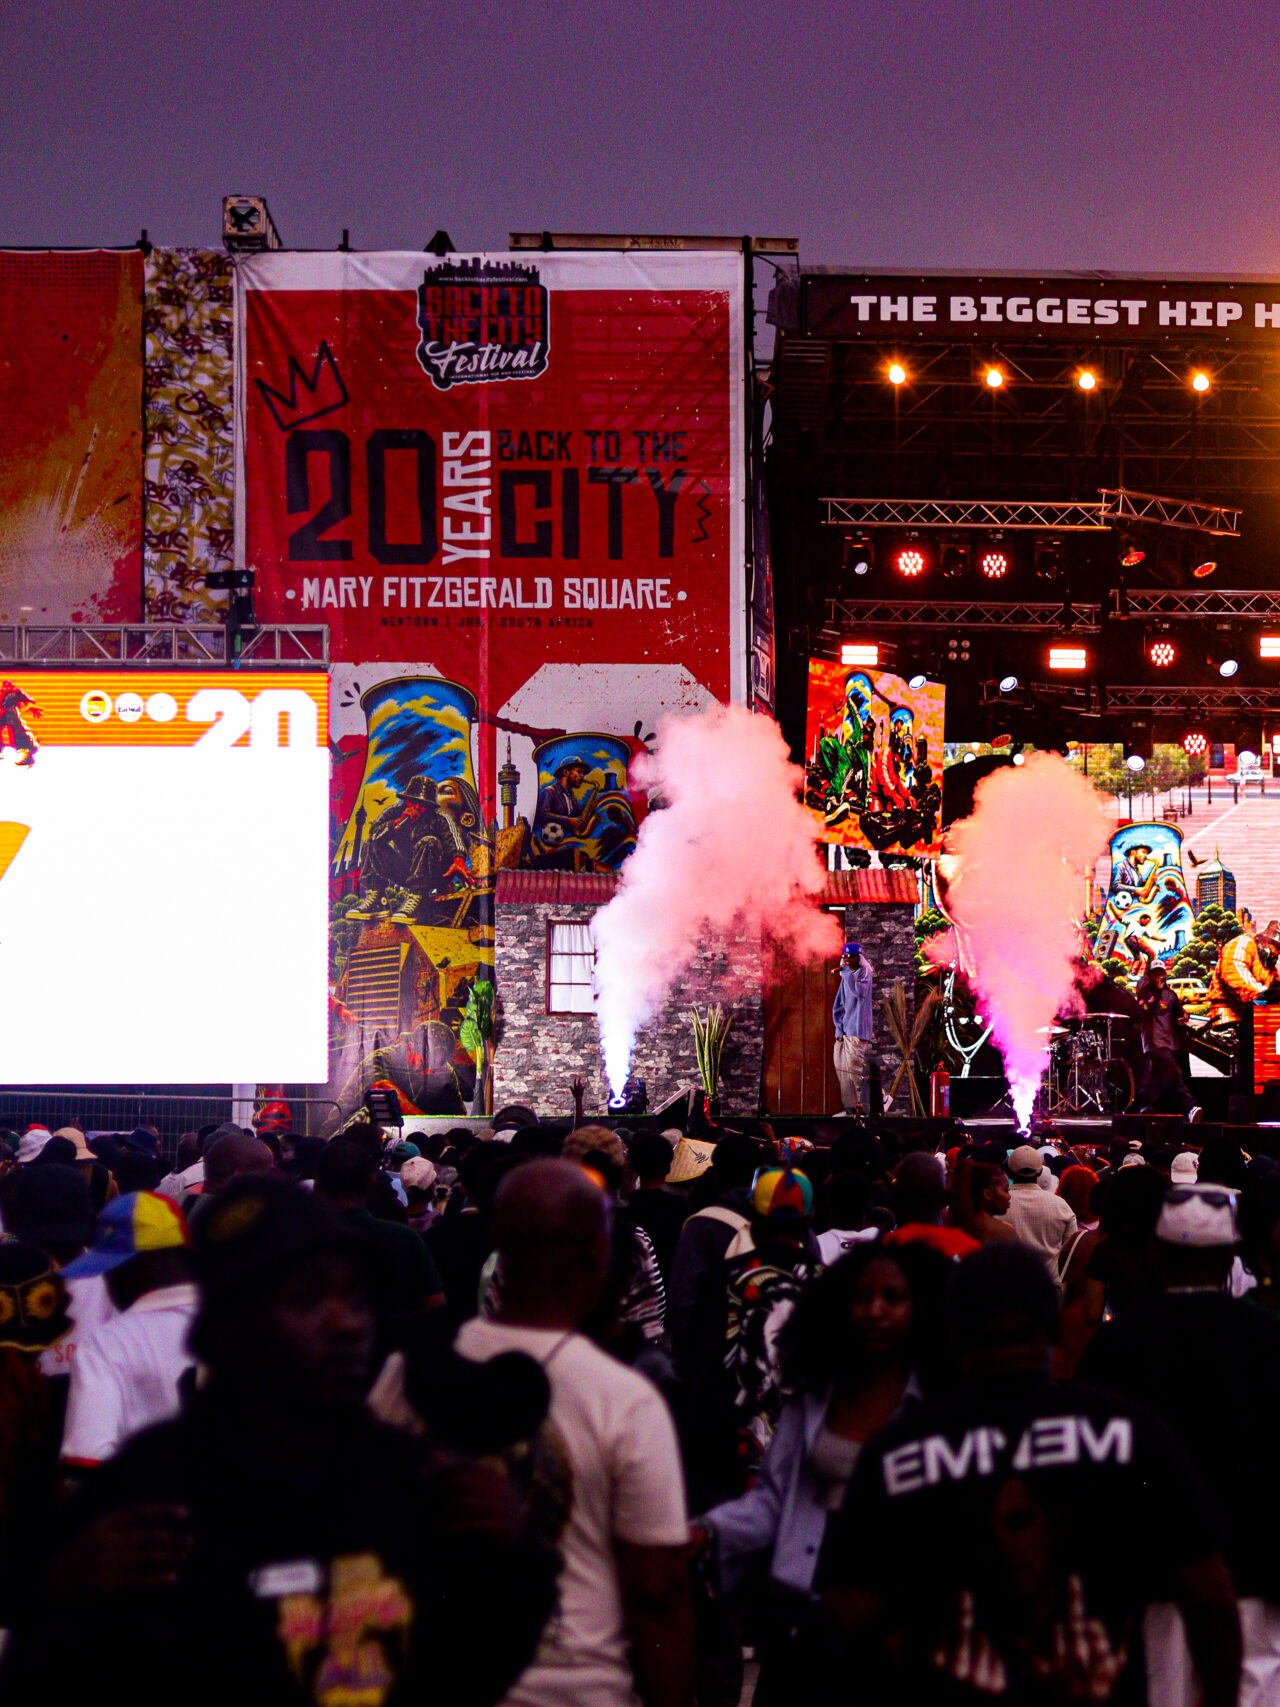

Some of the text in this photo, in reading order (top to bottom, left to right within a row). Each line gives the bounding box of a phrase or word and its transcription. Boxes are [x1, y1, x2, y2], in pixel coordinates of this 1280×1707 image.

[425, 286, 541, 316] BACK TO
[850, 295, 937, 322] THE
[950, 296, 1147, 326] BIGGEST
[1158, 300, 1243, 327] HIP
[425, 316, 541, 346] THE CITY
[425, 341, 541, 379] Festival
[498, 430, 690, 464] BACK TO THE
[285, 428, 437, 565] 20
[441, 430, 493, 566] YEARS
[499, 467, 691, 561] CITY
[302, 576, 672, 611] MARY FITZGERALD SQUARE
[186, 688, 318, 748] 20
